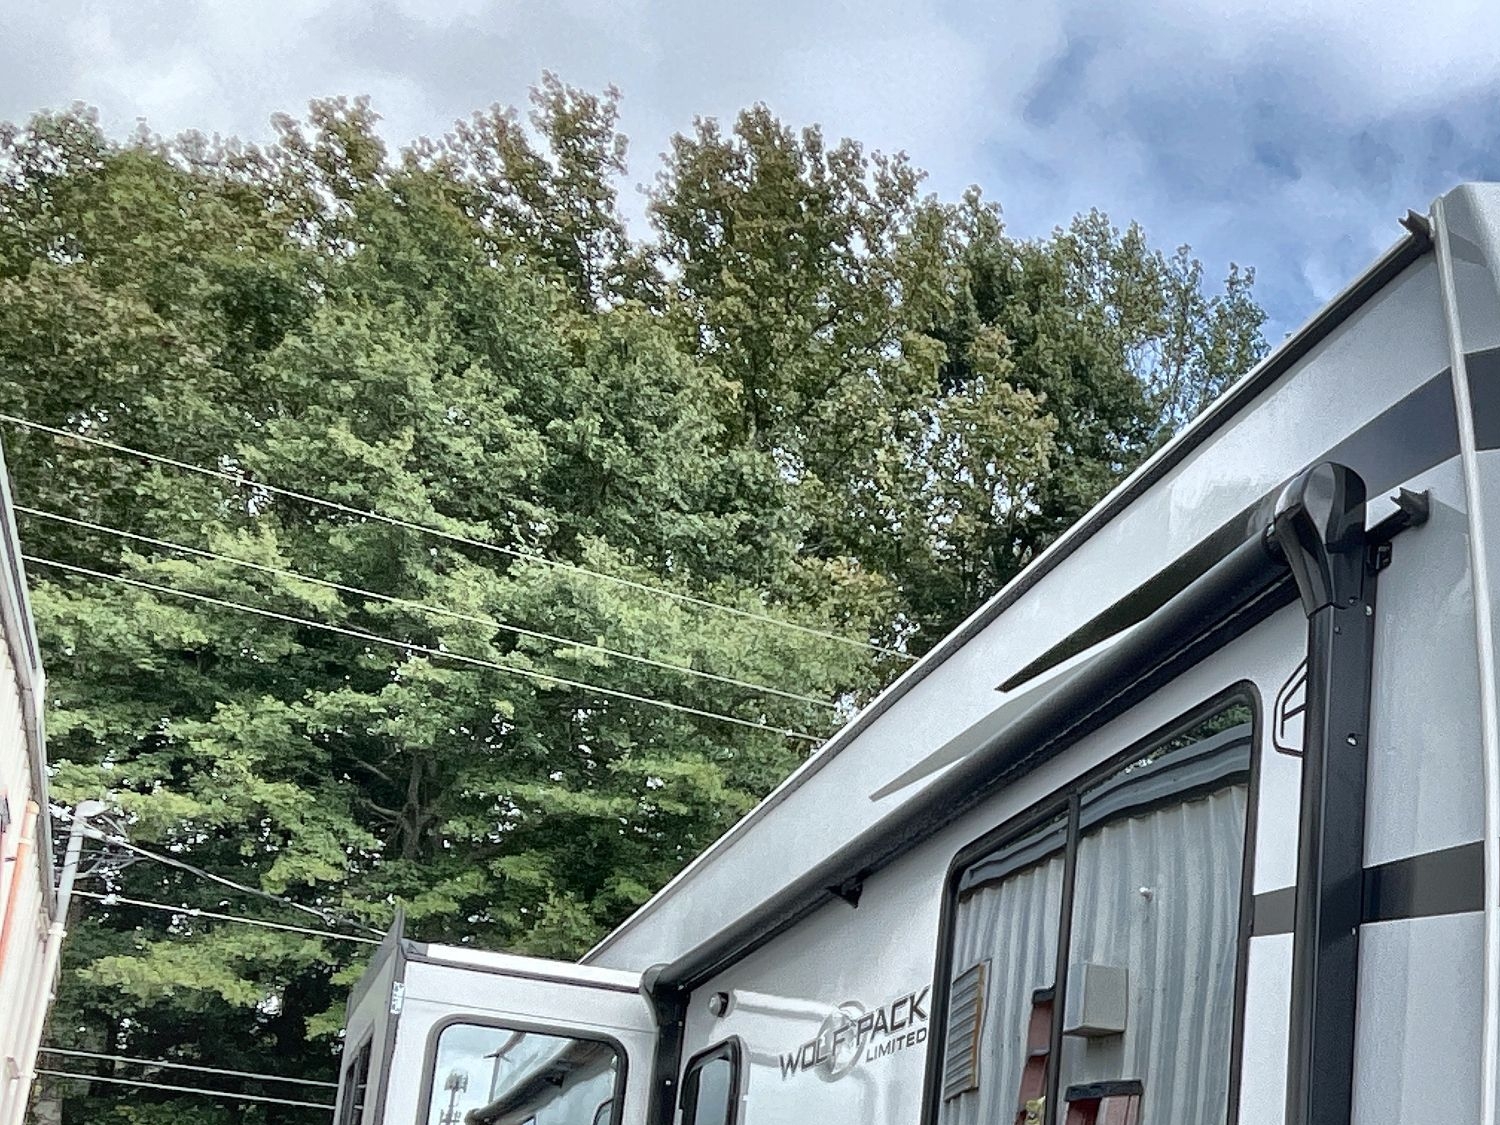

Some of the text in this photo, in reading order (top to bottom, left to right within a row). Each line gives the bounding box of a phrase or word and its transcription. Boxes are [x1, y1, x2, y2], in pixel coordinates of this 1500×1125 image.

[779, 985, 931, 1081] WOLF PACK
[866, 1027, 928, 1062] LIMITED
